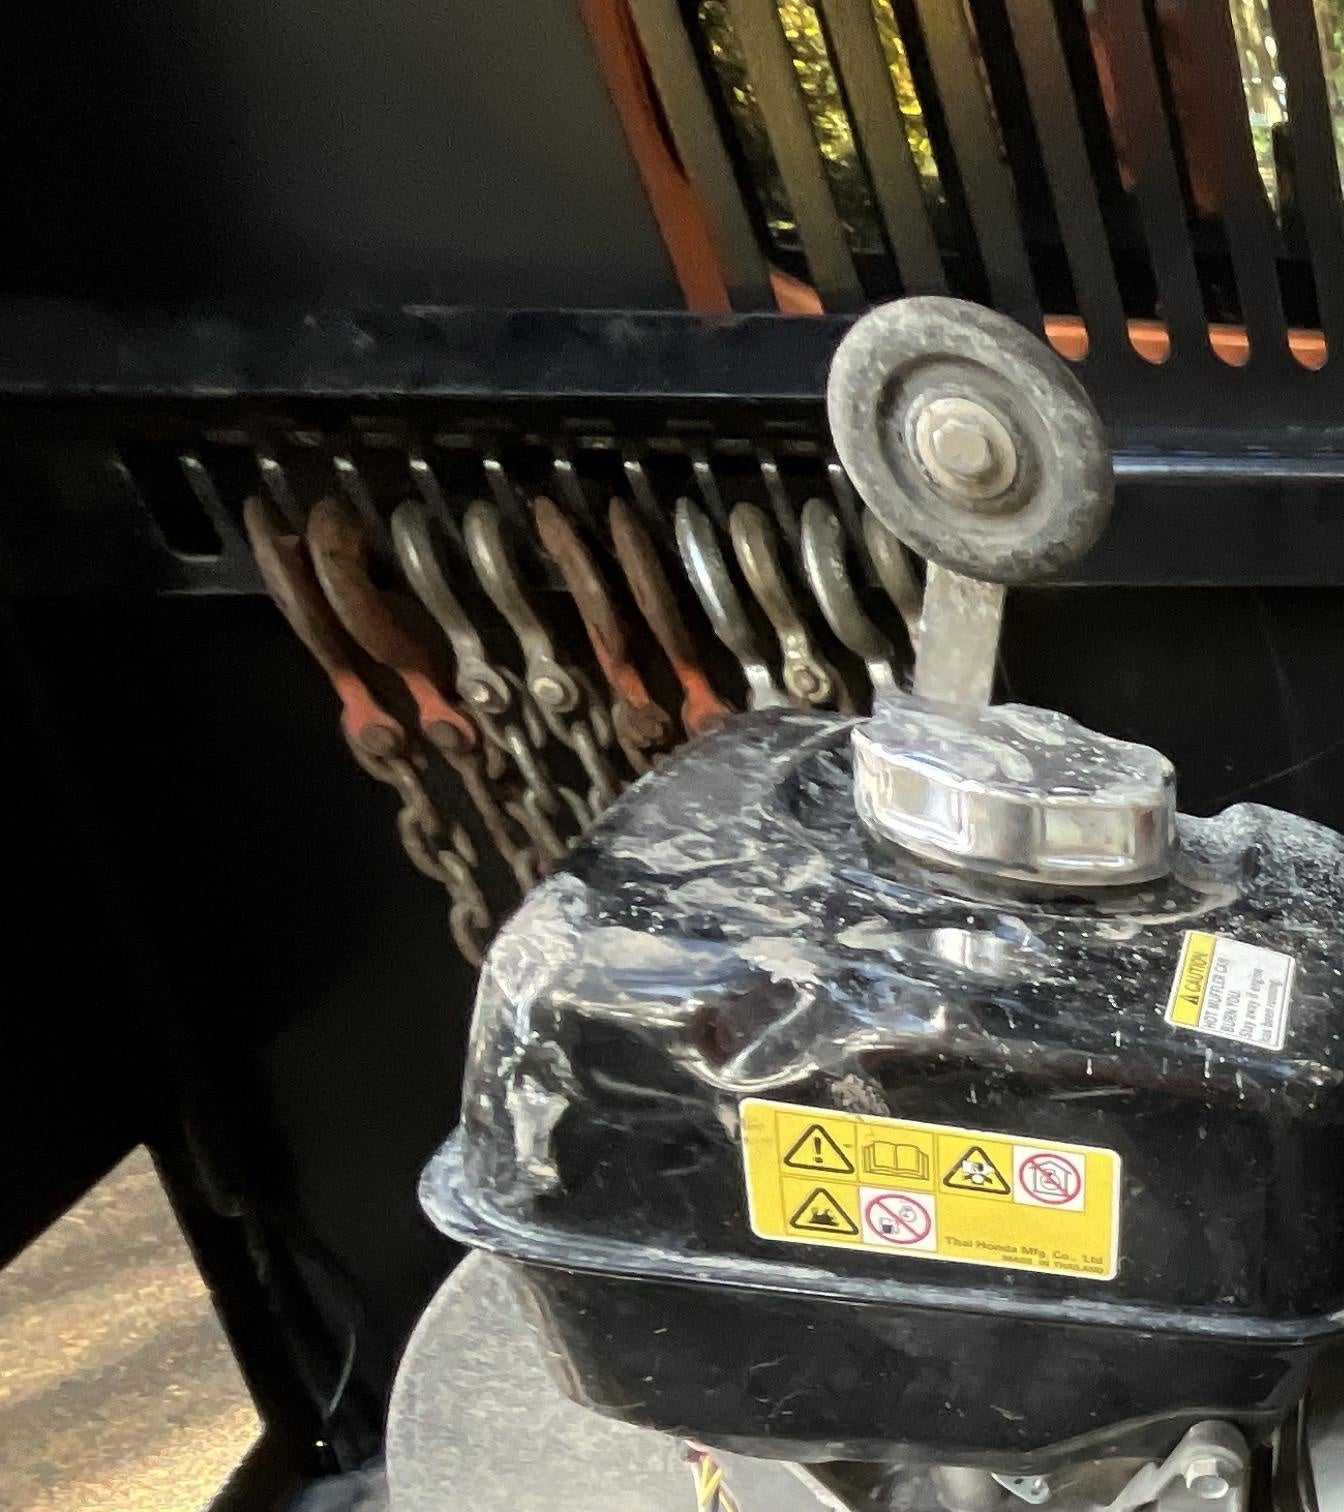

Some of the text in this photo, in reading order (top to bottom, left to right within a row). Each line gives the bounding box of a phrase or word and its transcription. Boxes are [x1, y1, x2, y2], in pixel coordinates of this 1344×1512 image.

[1183, 951, 1209, 994] CAUTION
[944, 1236, 974, 1248] Thai
[976, 1240, 1018, 1254] Honda
